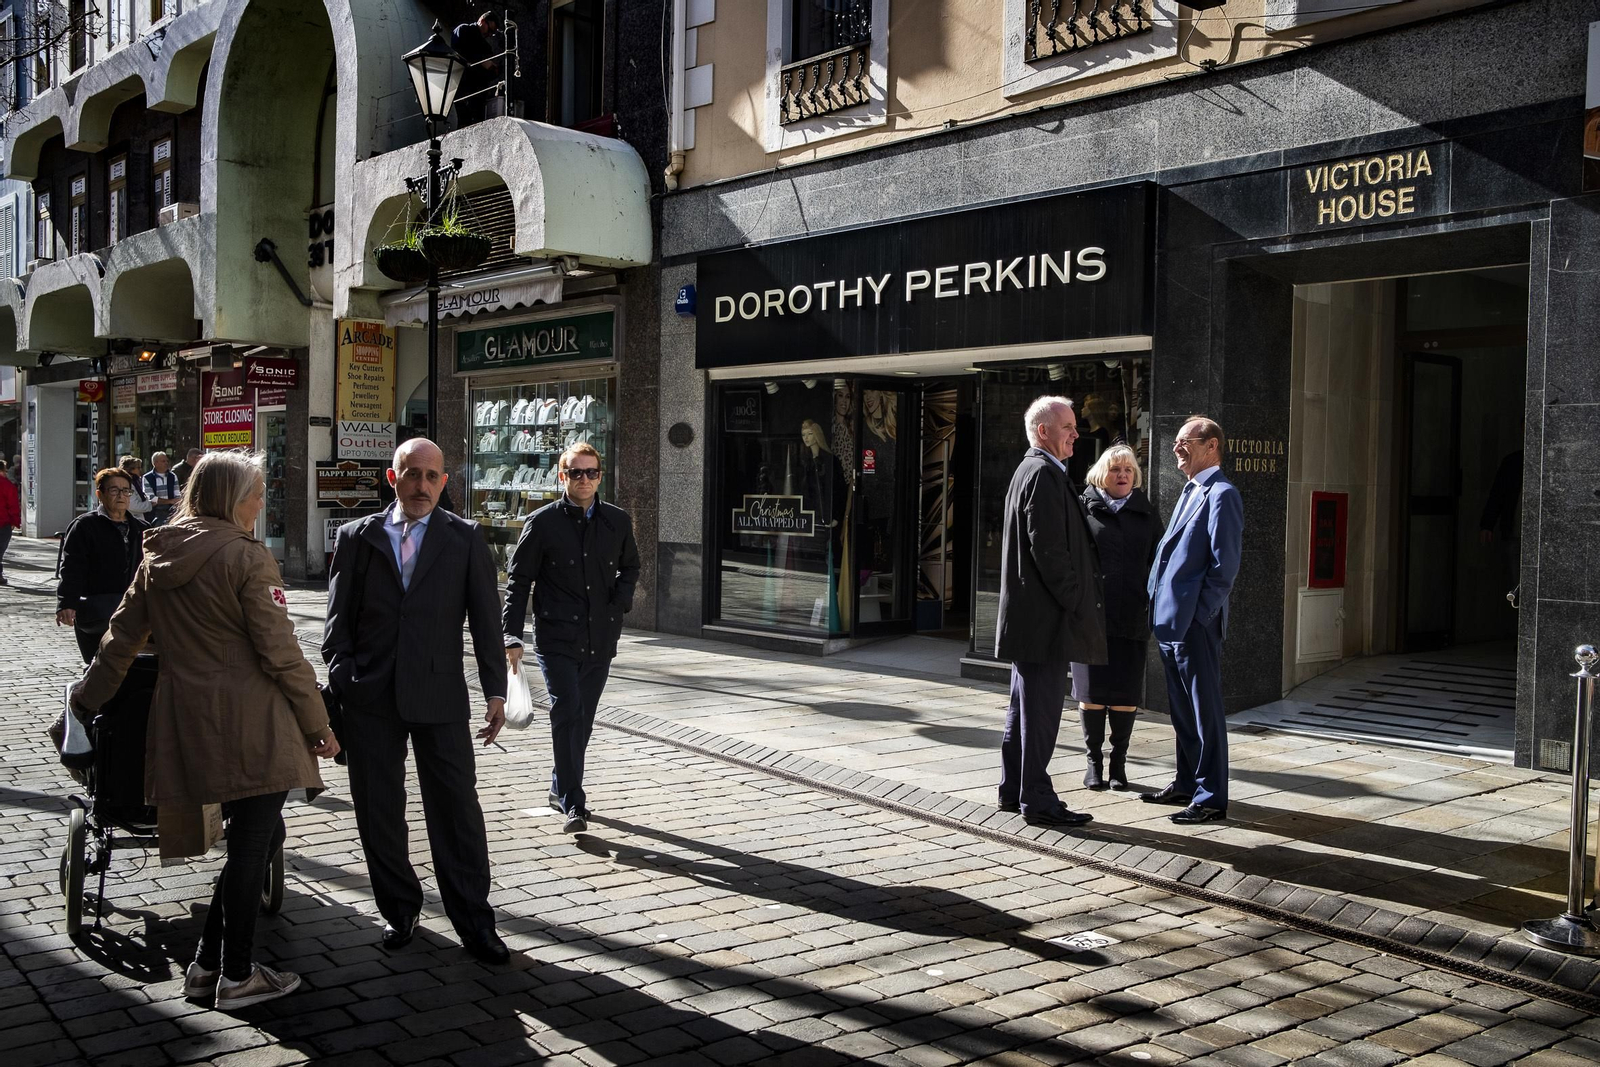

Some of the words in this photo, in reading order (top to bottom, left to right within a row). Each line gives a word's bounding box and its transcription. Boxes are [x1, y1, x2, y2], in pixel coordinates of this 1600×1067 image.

[1305, 149, 1433, 194] VICTORIA
[1317, 186, 1416, 225] HOUSE
[309, 209, 335, 239] DO
[715, 273, 892, 323] DOROTHY
[905, 246, 1107, 302] PERKINS
[437, 288, 500, 309] GLAMOUR
[361, 322, 377, 330] The
[341, 327, 394, 350] ARCADE
[484, 326, 579, 361] GLAMOUR
[255, 366, 296, 376] SONIC
[349, 363, 360, 371] Key
[362, 364, 384, 372] Cutters
[347, 372, 362, 380] Shoe
[363, 373, 385, 382] Repairs
[214, 386, 243, 398] SONIC
[353, 382, 380, 390] Perfumes
[352, 391, 380, 400] Jewellery
[350, 401, 382, 410] Newsagent
[204, 410, 224, 425] STORE
[224, 408, 253, 424] CLOSING
[351, 410, 380, 418] Groceries
[341, 421, 392, 434] WALK
[205, 434, 213, 444] ALL
[213, 433, 228, 443] STOCK
[340, 437, 395, 449] Outlet
[1227, 438, 1284, 455] VICTORIA
[363, 450, 378, 458] 70%
[1235, 457, 1276, 472] HOUSE
[750, 492, 795, 519] Christmas
[737, 516, 753, 527] ALL
[754, 515, 795, 529] WRAPPED
[796, 518, 807, 530] UP
